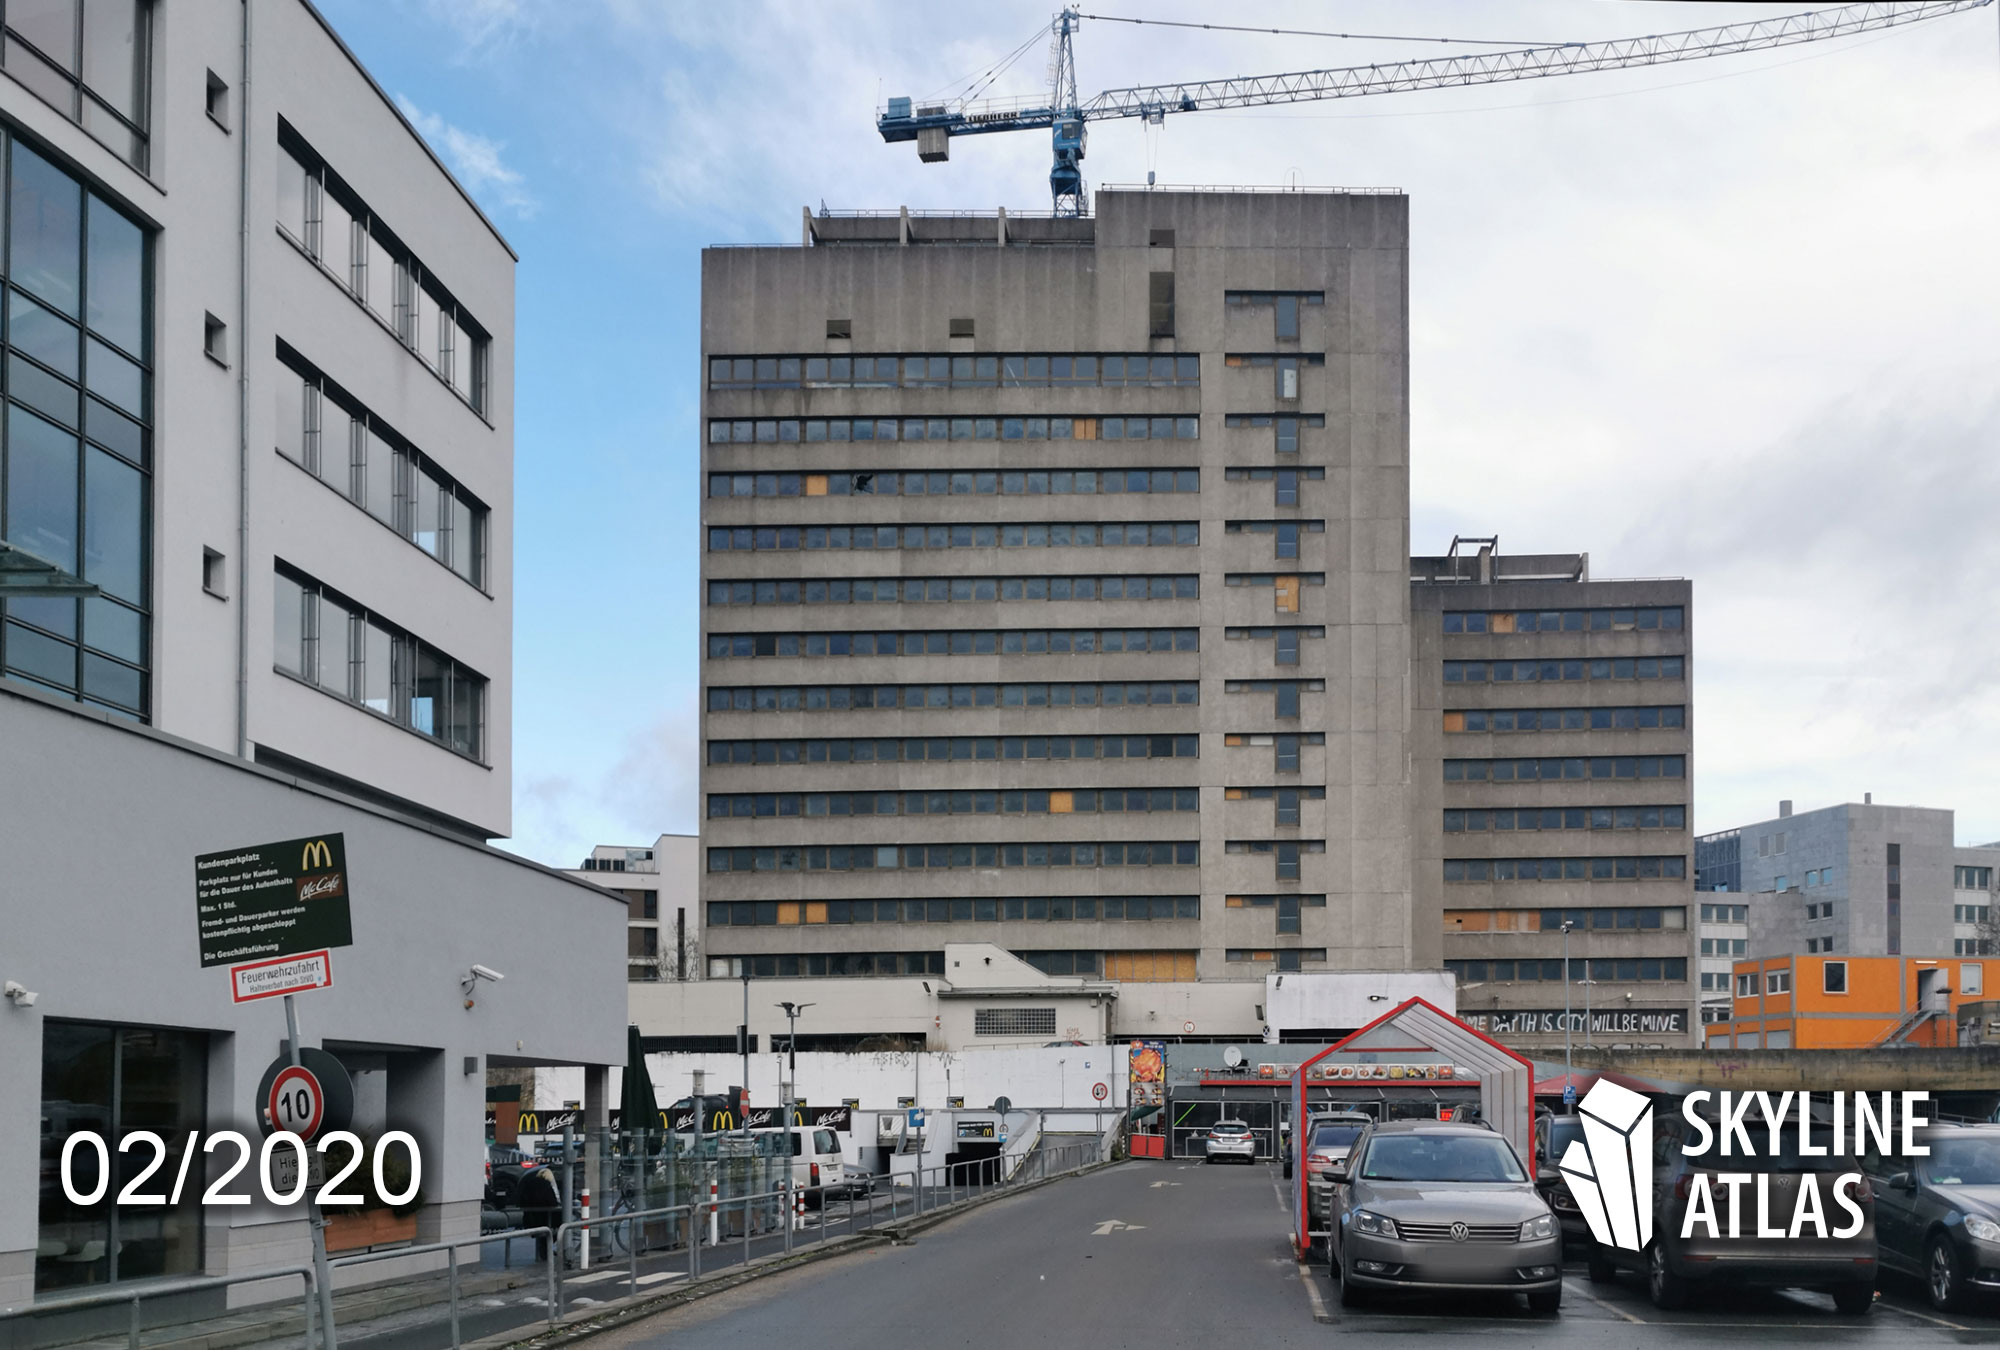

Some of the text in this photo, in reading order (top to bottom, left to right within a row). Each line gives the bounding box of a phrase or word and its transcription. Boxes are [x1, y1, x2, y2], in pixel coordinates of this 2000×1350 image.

[198, 853, 260, 870] Kundenparkplatz
[199, 877, 229, 887] Parkplatz
[242, 872, 252, 880] für
[253, 869, 278, 878] Kunden
[210, 888, 220, 896] die
[221, 886, 241, 894] Dauer
[241, 883, 254, 891] des
[255, 877, 293, 889] Aufenthalts
[200, 905, 216, 913] Max.
[223, 901, 237, 909] Std.
[202, 906, 306, 927] Fremd- und Dauerparker werden
[202, 918, 296, 939] kostenpflichtig abgeschleppt
[204, 943, 279, 960] Die Geschäftsführung
[241, 960, 320, 984] Feuerwehrzufahrt
[249, 981, 283, 993] Halteverbot
[284, 978, 299, 987] nach
[1641, 1014, 1679, 1032] MINE
[280, 1088, 310, 1123] 10
[280, 1157, 298, 1169] Hie
